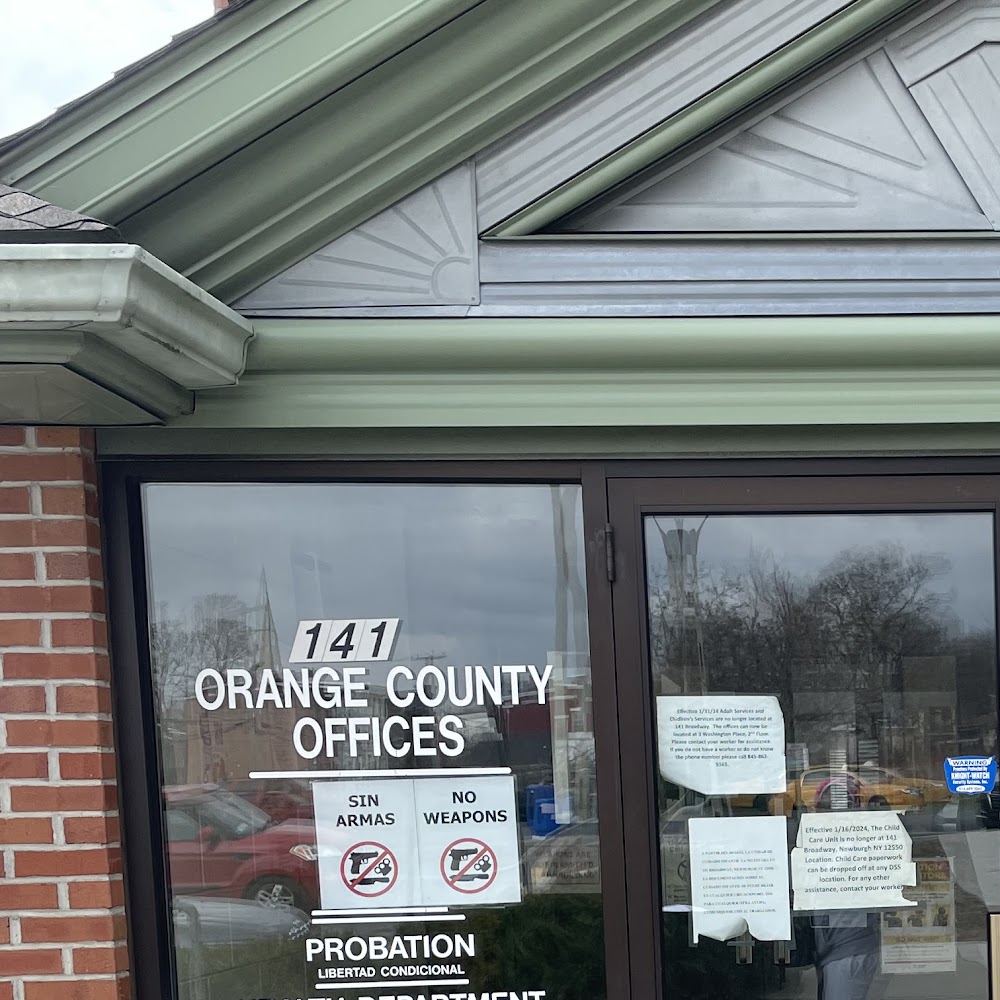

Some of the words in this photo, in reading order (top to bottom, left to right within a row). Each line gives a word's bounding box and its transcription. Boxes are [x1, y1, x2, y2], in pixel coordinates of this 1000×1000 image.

[305, 622, 387, 659] 141
[195, 667, 368, 710] ORANGE
[386, 665, 553, 707] COUNTY
[293, 715, 465, 759] OFFICES
[349, 795, 379, 808] SIN
[452, 791, 477, 804] NO
[336, 813, 395, 827] ARMAS
[423, 810, 507, 825] WEAPONS
[829, 865, 856, 873] dropped
[305, 934, 475, 961] PROBATION
[318, 967, 376, 979] LIBERTAD
[380, 965, 465, 977] CONDICIONAL
